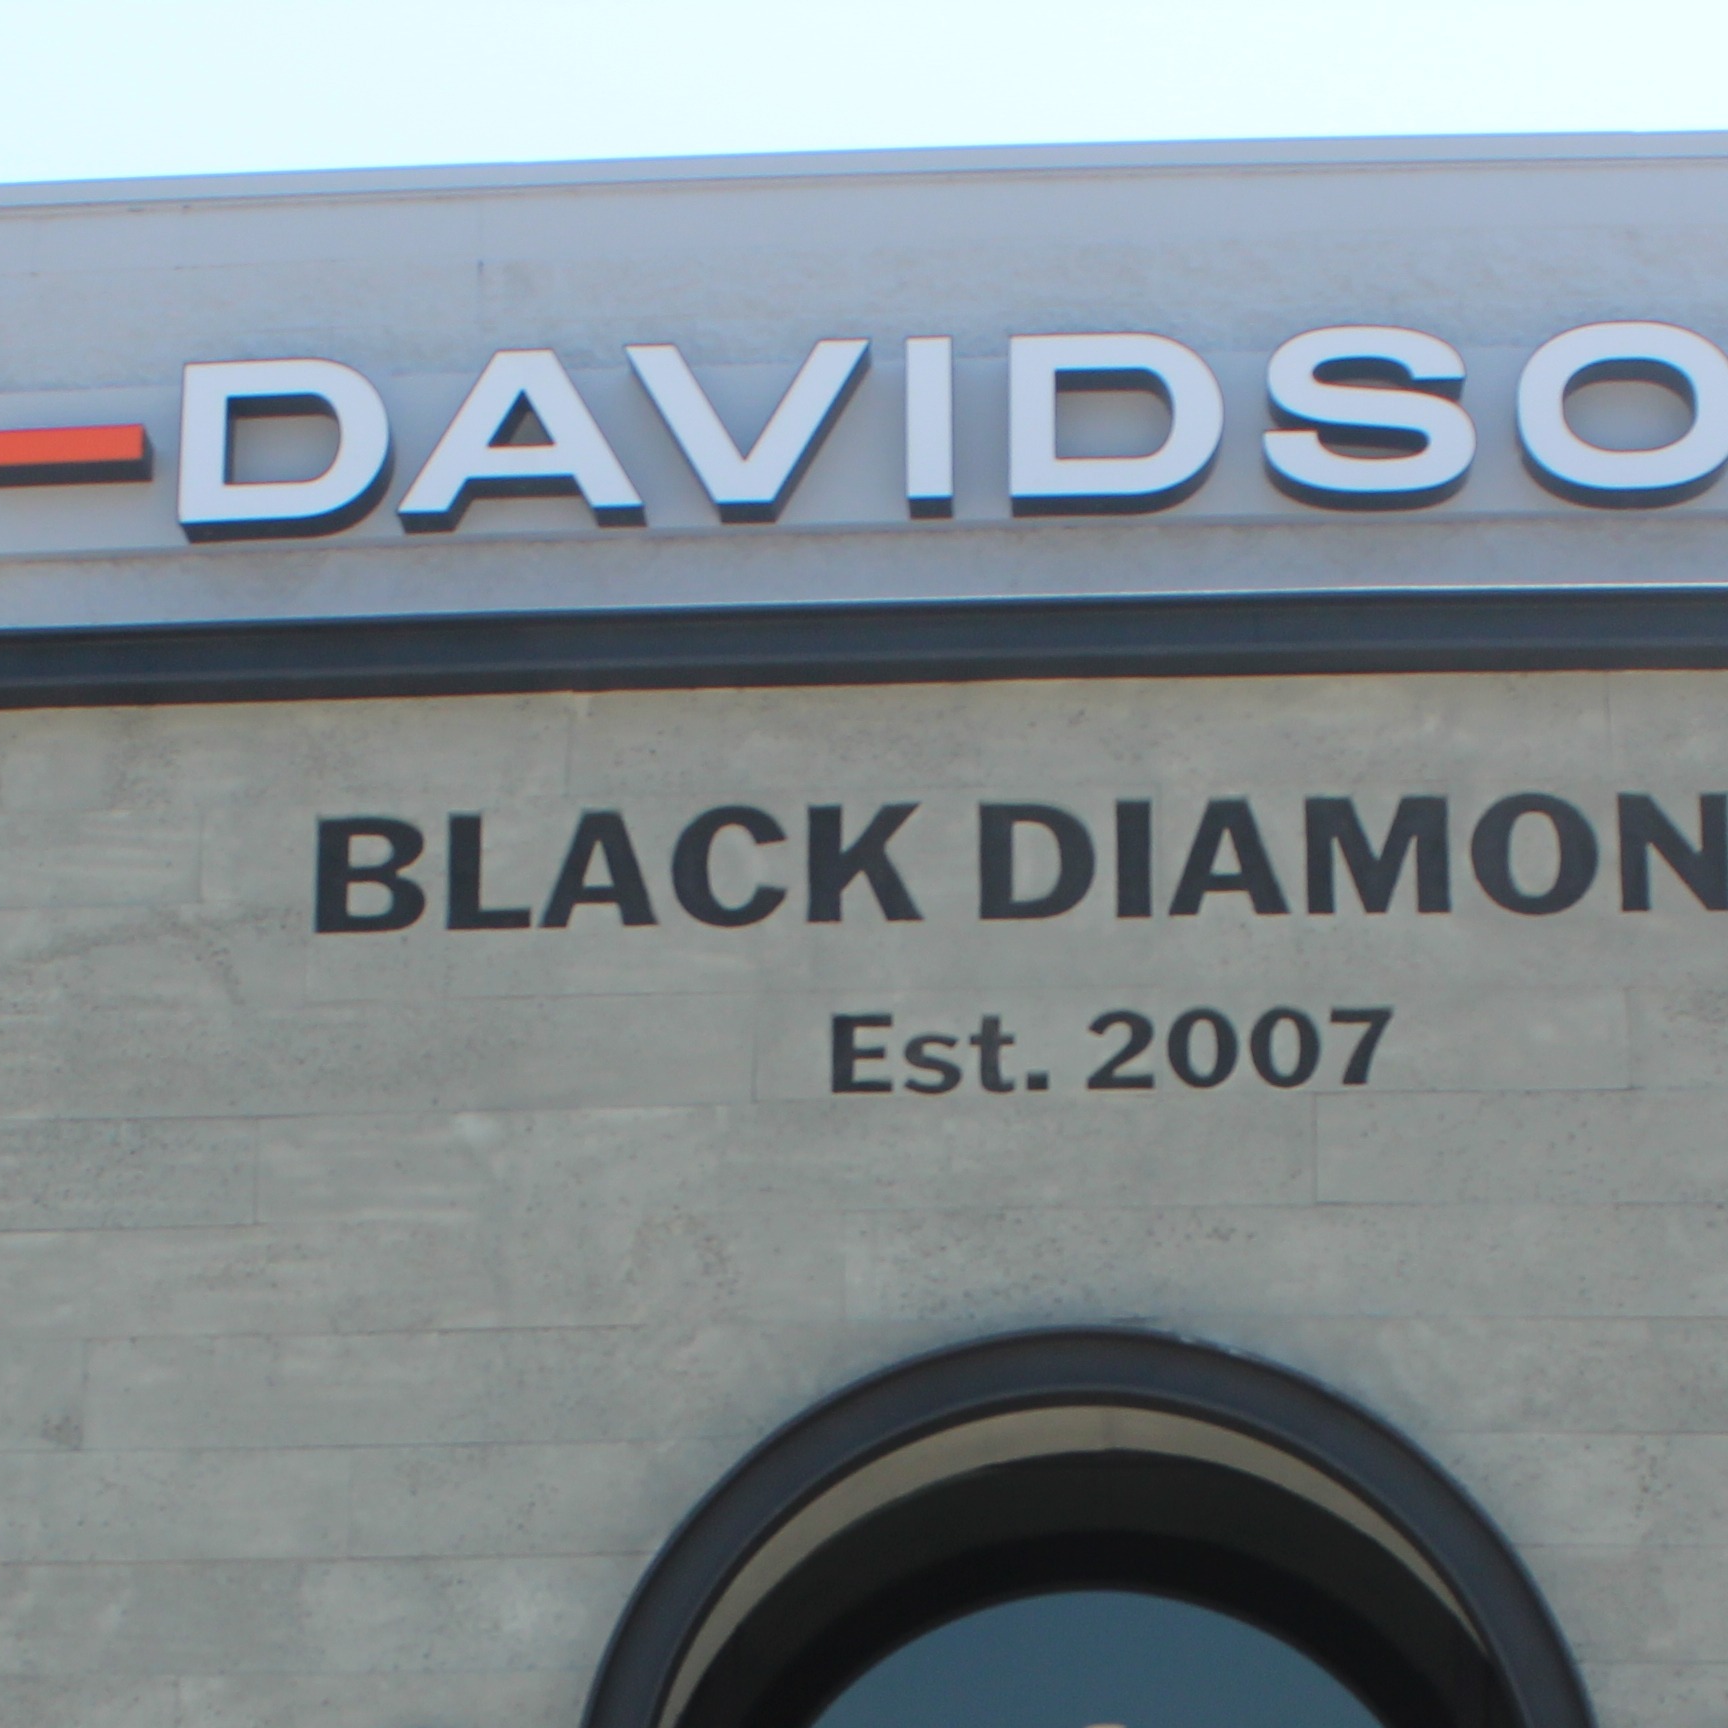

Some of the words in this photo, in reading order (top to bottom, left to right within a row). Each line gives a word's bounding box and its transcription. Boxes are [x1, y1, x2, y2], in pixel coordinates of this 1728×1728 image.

[313, 800, 924, 935] BLACK
[827, 1011, 1052, 1097] Est.
[1084, 1007, 1396, 1091] 2007
